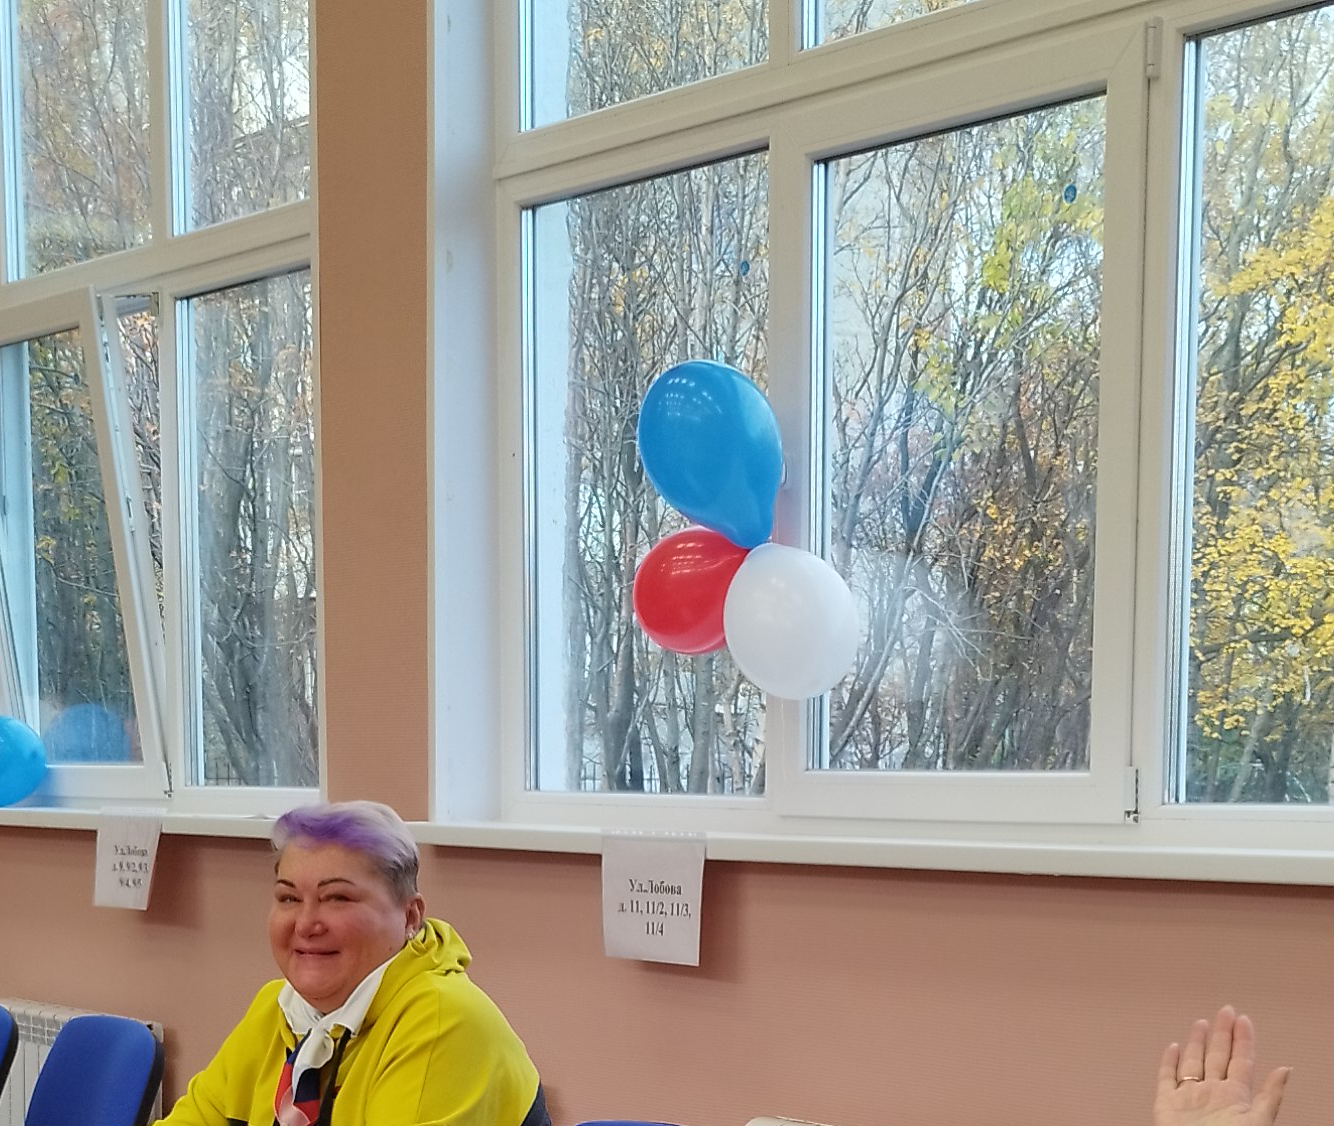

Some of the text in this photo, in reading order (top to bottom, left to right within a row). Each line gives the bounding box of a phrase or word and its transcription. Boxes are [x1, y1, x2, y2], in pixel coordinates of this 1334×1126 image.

[631, 900, 643, 915] 11,
[647, 901, 668, 917] 11/2,
[670, 902, 692, 919] 11/3,
[645, 921, 664, 936] 11/4
